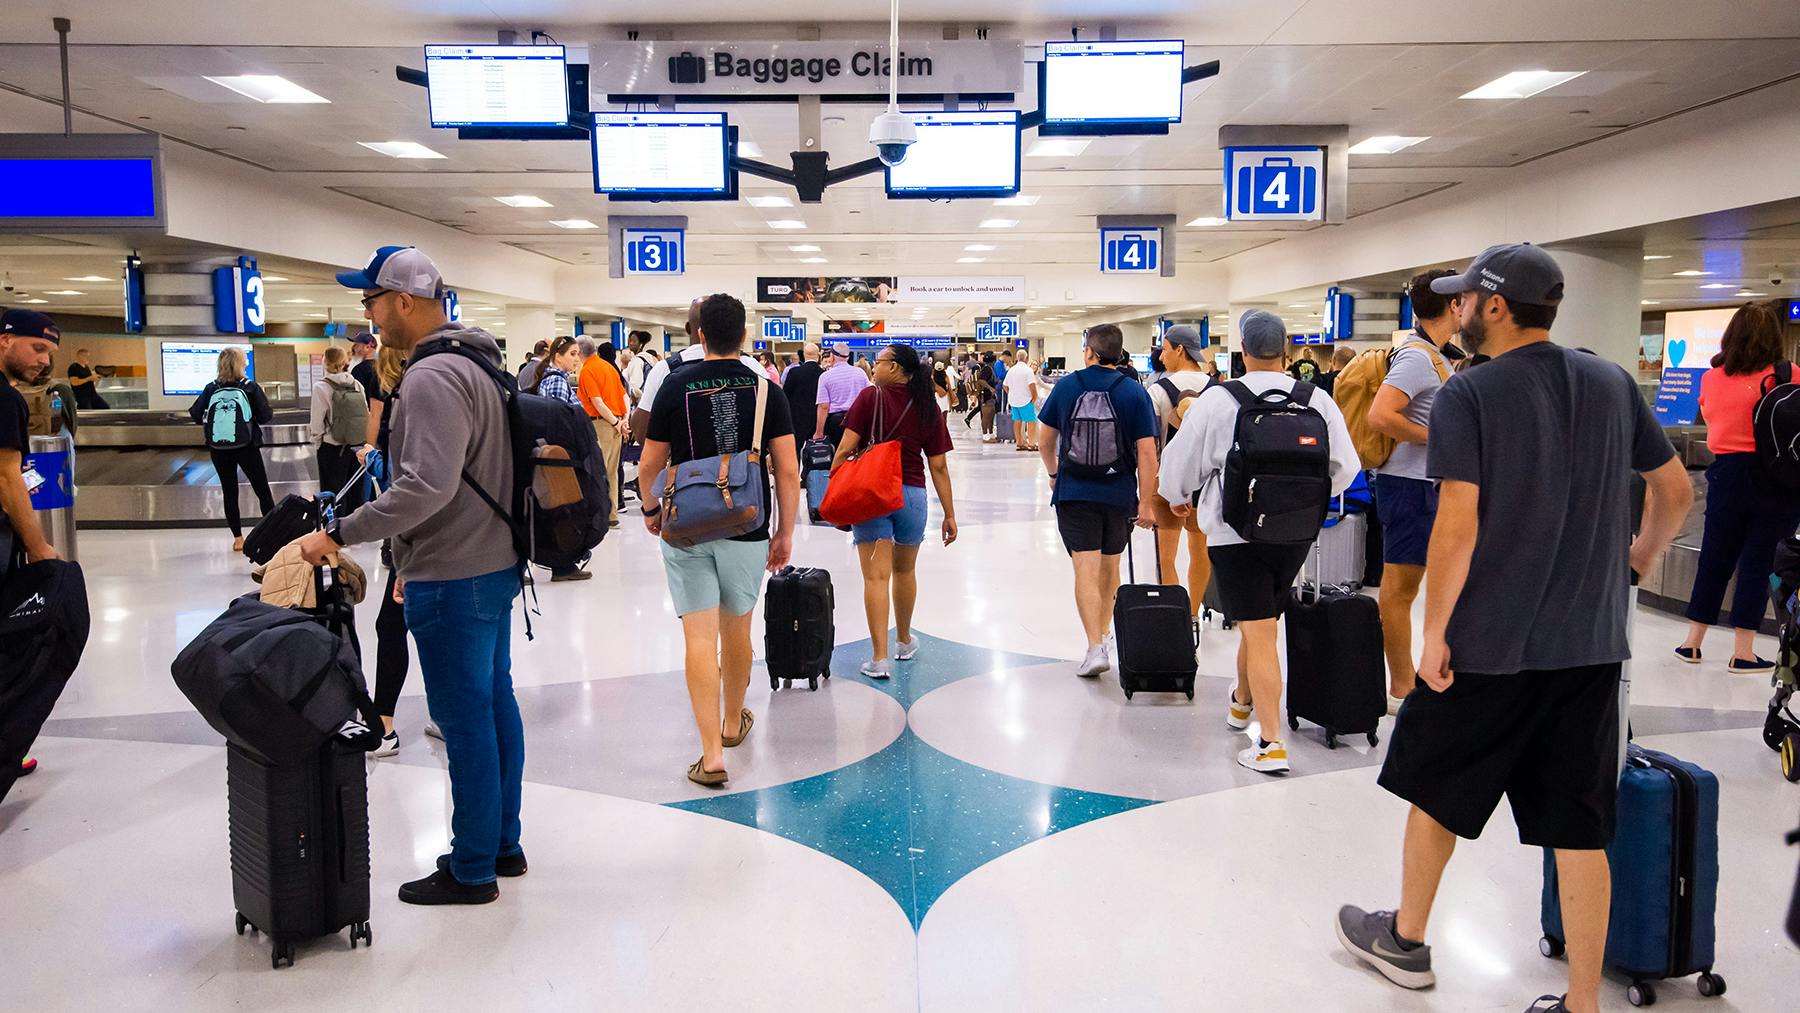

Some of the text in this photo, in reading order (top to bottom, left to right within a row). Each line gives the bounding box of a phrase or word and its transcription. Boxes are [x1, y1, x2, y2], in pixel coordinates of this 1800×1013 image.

[715, 51, 933, 84] Baggage Claim
[1263, 171, 1290, 209] 4
[644, 244, 661, 269] 3
[1123, 243, 1141, 267] 4
[1480, 268, 1505, 283] Arizona
[246, 276, 265, 327] 3
[773, 323, 780, 336] 1
[791, 329, 796, 340] 1
[1001, 322, 1010, 335] 2
